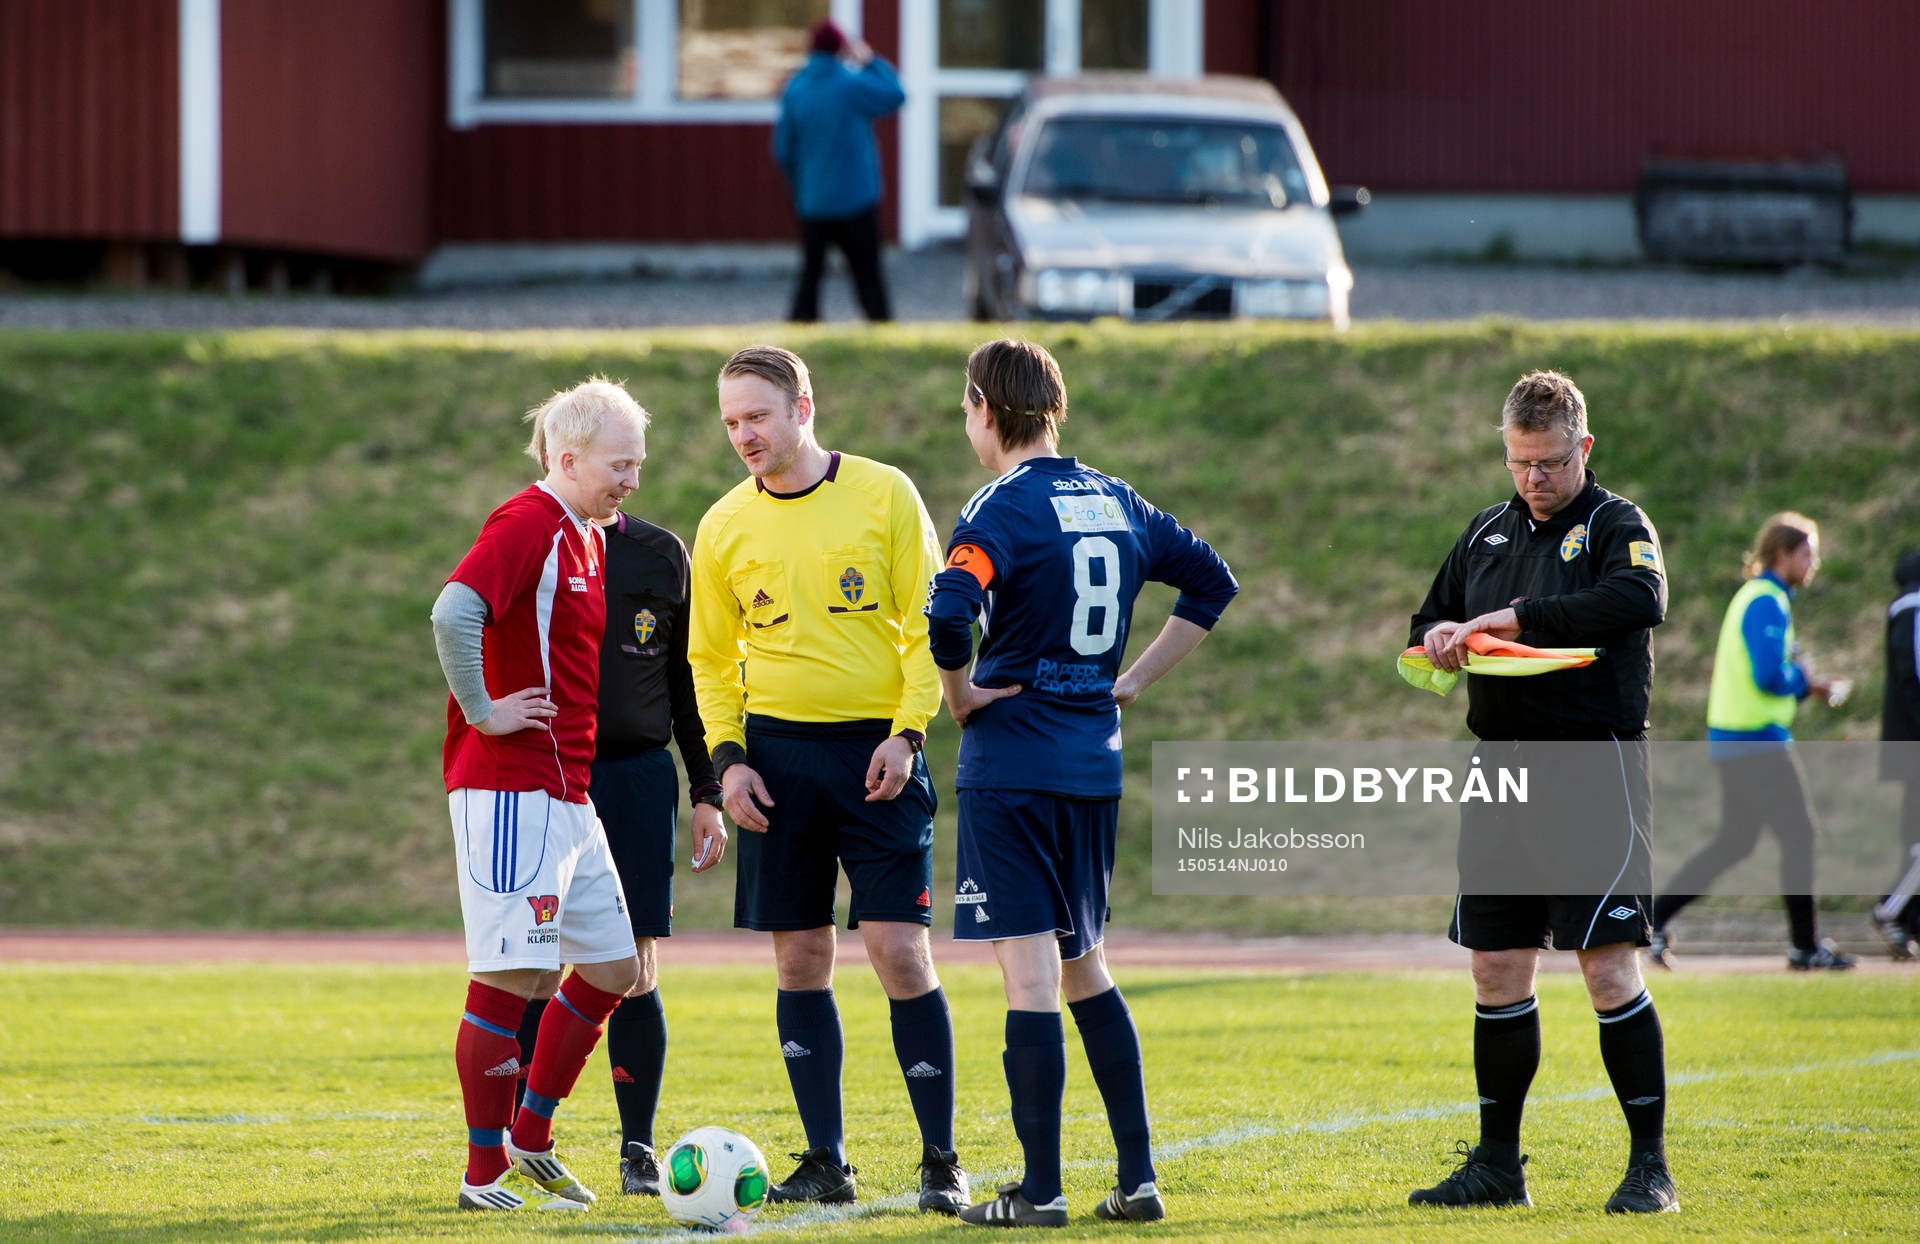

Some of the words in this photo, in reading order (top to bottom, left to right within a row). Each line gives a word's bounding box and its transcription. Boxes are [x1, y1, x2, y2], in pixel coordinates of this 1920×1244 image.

[950, 545, 974, 567] C
[752, 598, 775, 609] adidas
[1069, 535, 1121, 656] 8
[484, 1064, 520, 1077] adida
